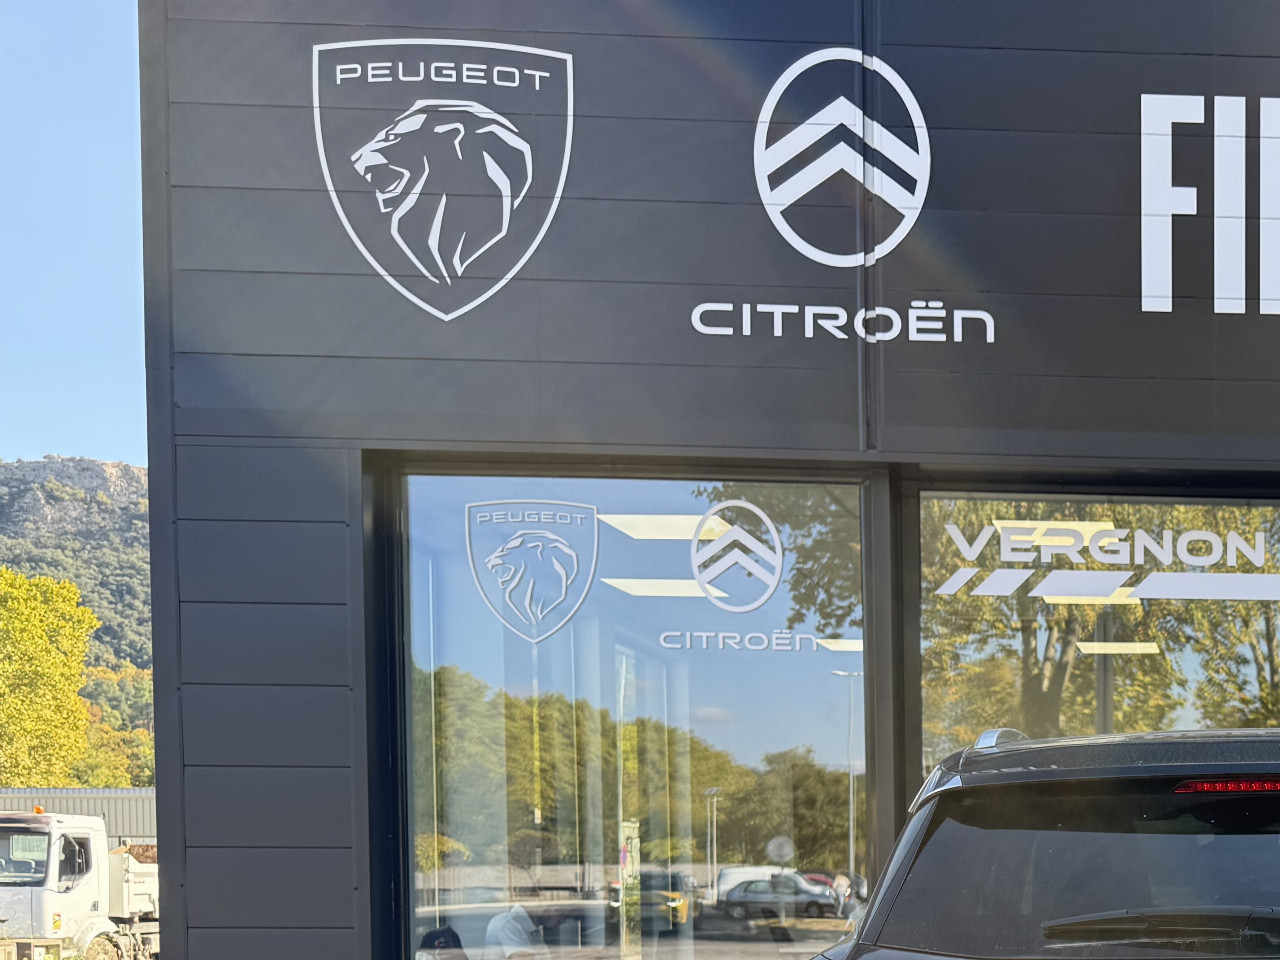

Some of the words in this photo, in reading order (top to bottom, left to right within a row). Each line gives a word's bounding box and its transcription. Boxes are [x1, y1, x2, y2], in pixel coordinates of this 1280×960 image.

[335, 61, 551, 91] PEUGEOT
[690, 300, 995, 344] CITROËN
[476, 510, 588, 525] PEUGEOT
[944, 522, 1266, 568] VERGNON
[659, 628, 818, 651] CITROËN
